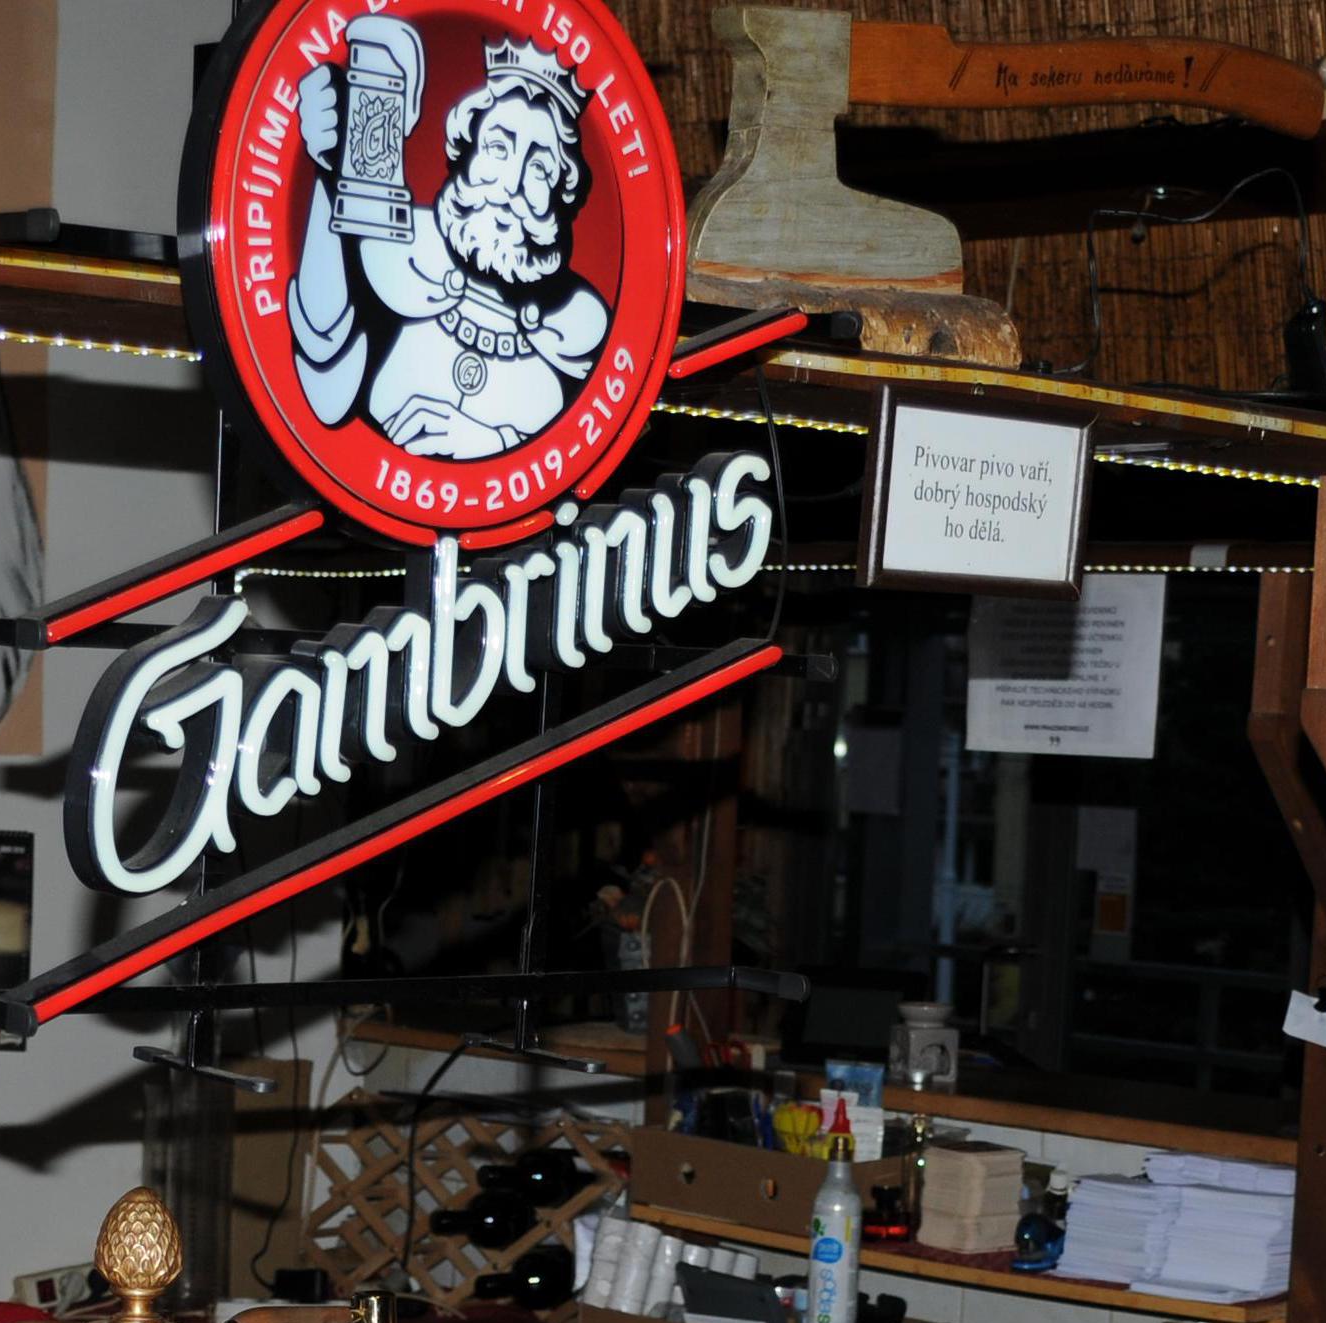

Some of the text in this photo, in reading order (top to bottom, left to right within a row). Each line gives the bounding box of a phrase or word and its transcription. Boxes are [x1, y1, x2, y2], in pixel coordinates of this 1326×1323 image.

[541, 3, 649, 178] 150 LET!
[1030, 66, 1083, 89] sekeru
[245, 9, 348, 317] PŘIPÍJÍME NA
[375, 347, 634, 514] 1869-2019-2169
[913, 445, 1053, 484] Pivovar pivo vaří,
[914, 479, 1048, 520] dobrý hospodský
[944, 516, 1005, 544] ho dělá.
[93, 452, 773, 894] Gambrinus
